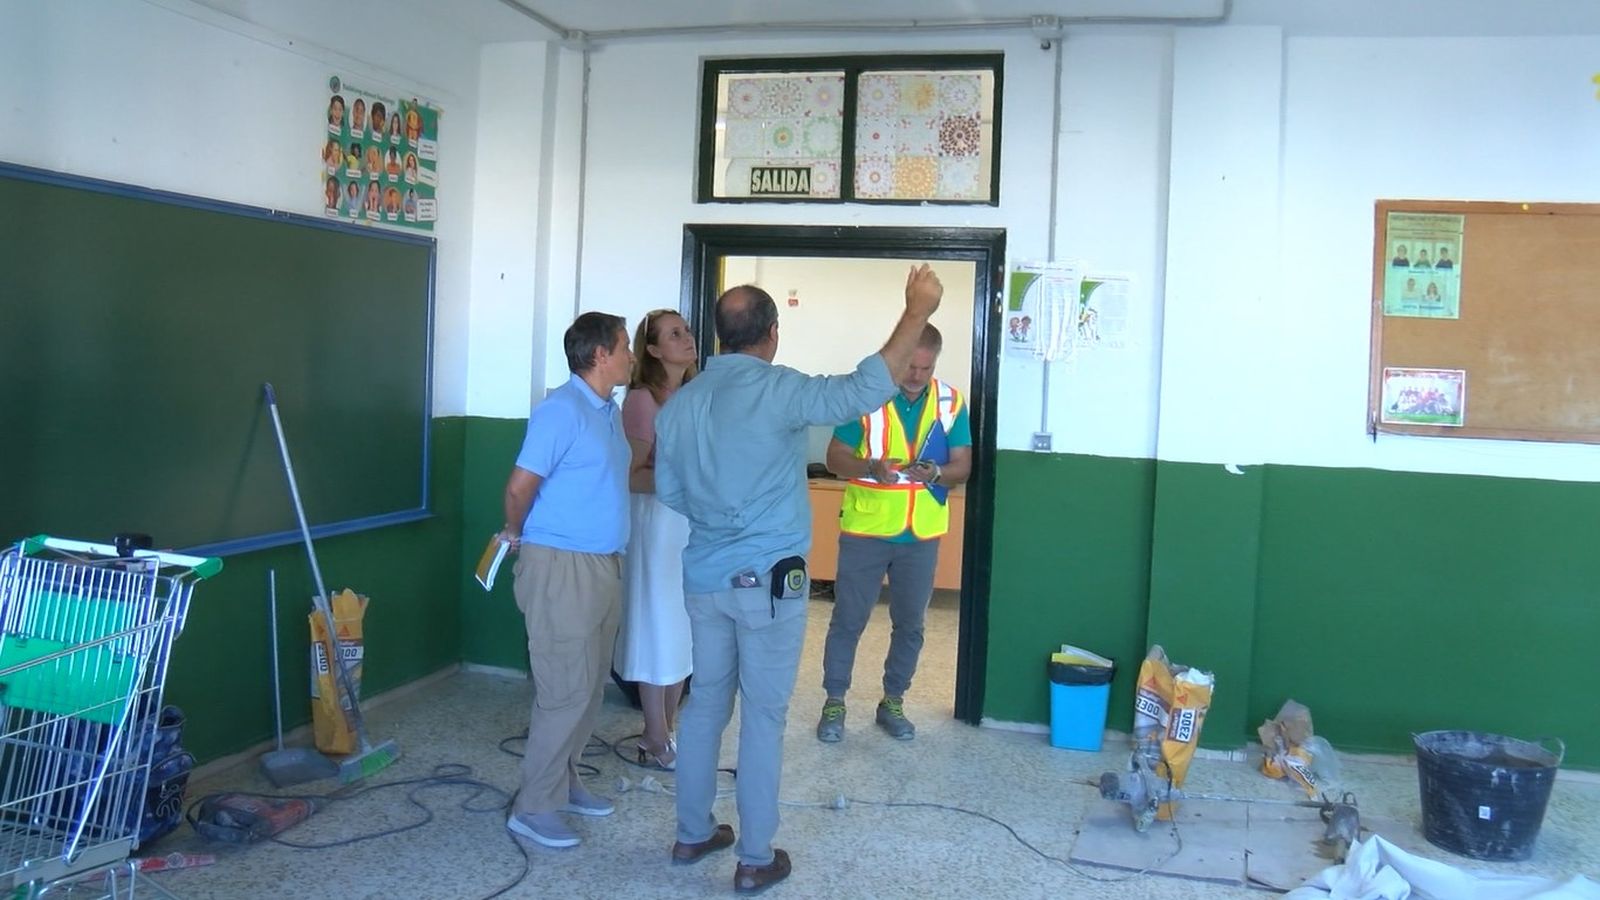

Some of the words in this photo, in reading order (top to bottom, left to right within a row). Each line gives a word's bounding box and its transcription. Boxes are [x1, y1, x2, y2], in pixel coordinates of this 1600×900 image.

[752, 169, 810, 192] SALIDA
[1136, 697, 1160, 716] 2300
[1178, 711, 1193, 740] 2300
